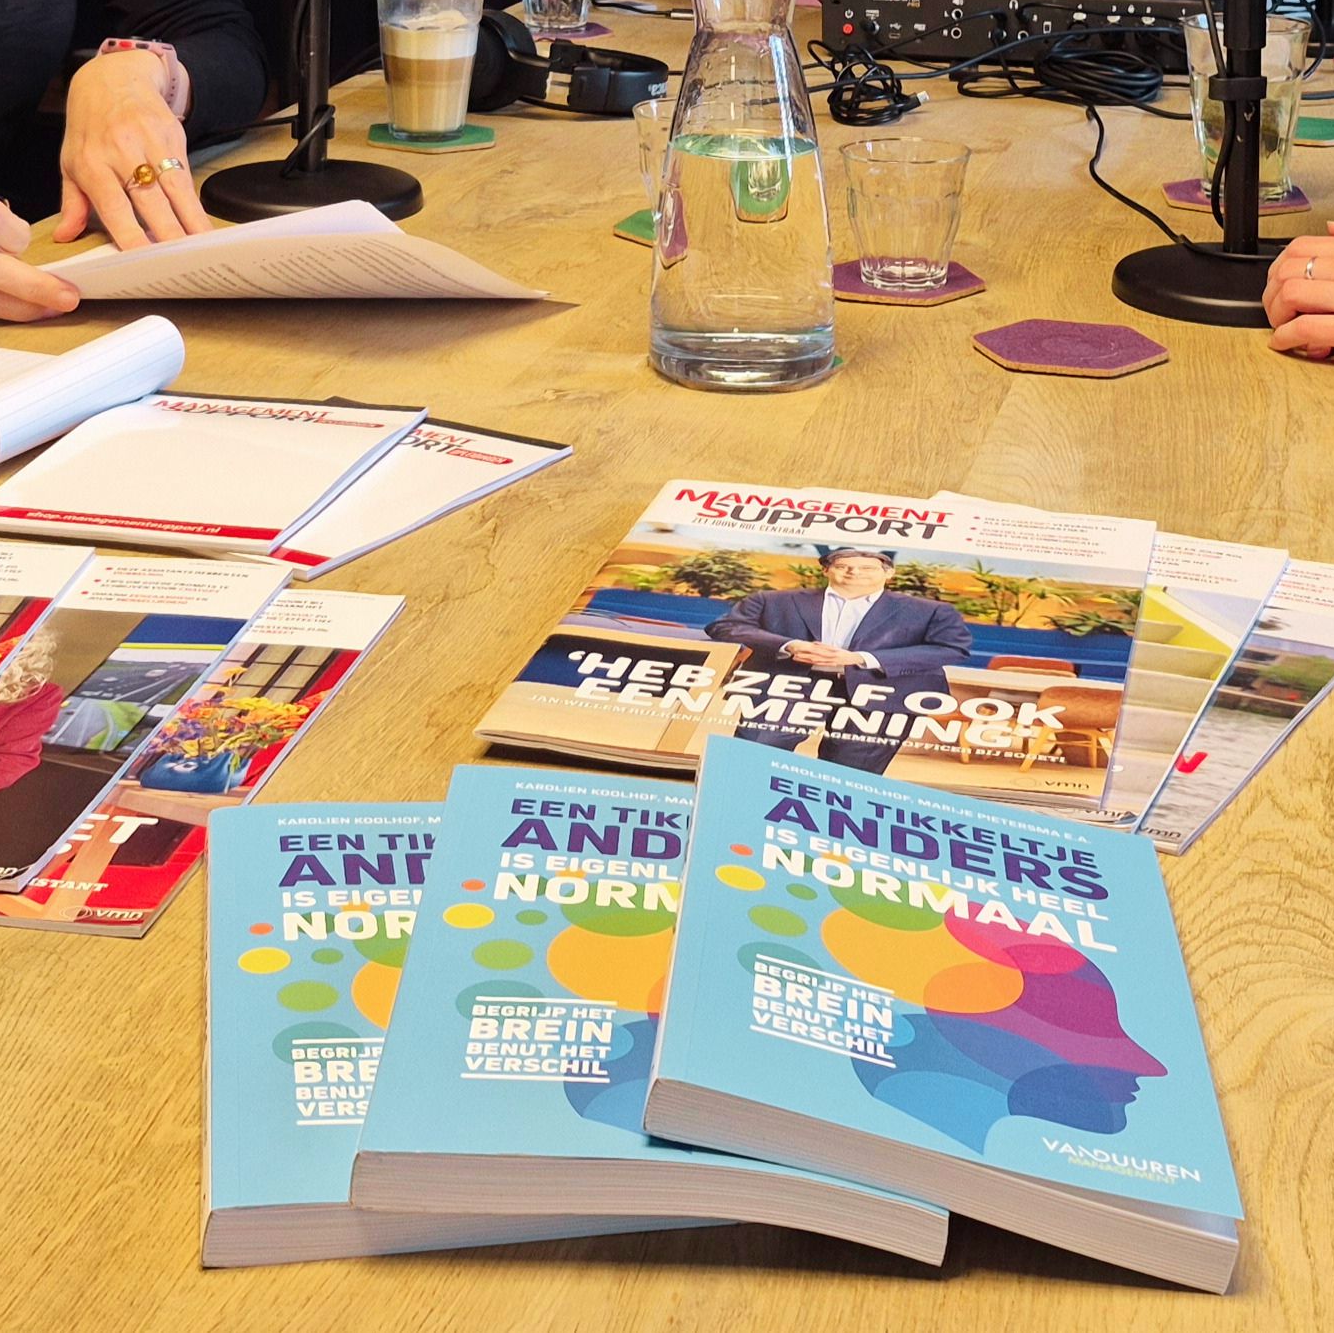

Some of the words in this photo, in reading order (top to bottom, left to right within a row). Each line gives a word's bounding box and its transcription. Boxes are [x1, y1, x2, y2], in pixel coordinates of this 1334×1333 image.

[675, 488, 955, 524] MANAGEMENT
[696, 502, 949, 540] SUPPORT
[567, 650, 717, 692] 'HEB
[721, 669, 898, 709] ZELF
[903, 690, 1069, 731] OOK
[574, 676, 715, 713] EEN
[781, 725, 902, 748] MANAGEMENT
[902, 740, 973, 755] OFFICER
[975, 748, 1000, 758] BIJ
[515, 781, 587, 795] KAROLIEN
[590, 787, 661, 803] KOOLHOF,
[770, 760, 842, 785] KAROLIEN
[844, 779, 915, 805] KOOLHOF,
[917, 796, 974, 817] MARIJE
[976, 811, 1060, 840] PIETERSMA
[1044, 779, 1091, 790] vmn
[277, 816, 351, 827] KAROLIEN
[354, 815, 425, 826] KOOLHOF,
[510, 798, 597, 821] EEN
[611, 806, 690, 830] TIK
[769, 775, 853, 811] EEN
[866, 801, 1098, 869] TIKKELTJE
[279, 834, 366, 853] EEN
[500, 818, 682, 861] AND
[764, 796, 1110, 901] ANDERS
[500, 852, 536, 870] IS
[545, 855, 679, 882] EIGENL
[764, 825, 800, 845] IS
[809, 834, 1000, 898] EIGENLIJK
[1011, 882, 1110, 922] HEEL
[93, 907, 145, 920] vmn
[282, 890, 317, 908] IS
[761, 843, 1118, 953] NORMAAL
[282, 910, 418, 941] NOR
[753, 961, 847, 993] BEGRIJP
[851, 987, 895, 1007] HET
[471, 1004, 567, 1018] BEGRIJP
[571, 1007, 617, 1021] HET
[753, 973, 893, 1029] BREIN
[468, 1017, 613, 1044] BREIN
[751, 1009, 894, 1060] VERSCHIL
[752, 995, 837, 1028] BENUT
[843, 1020, 895, 1044] HET
[464, 1056, 609, 1076] VERSCHIL
[465, 1042, 554, 1057] BENUT
[559, 1044, 612, 1059] HET
[294, 1060, 380, 1084] BRE
[296, 1100, 370, 1117] VERS
[1042, 1136, 1202, 1183] VANDUUREN
[1068, 1155, 1177, 1185] MANAGEMENT
